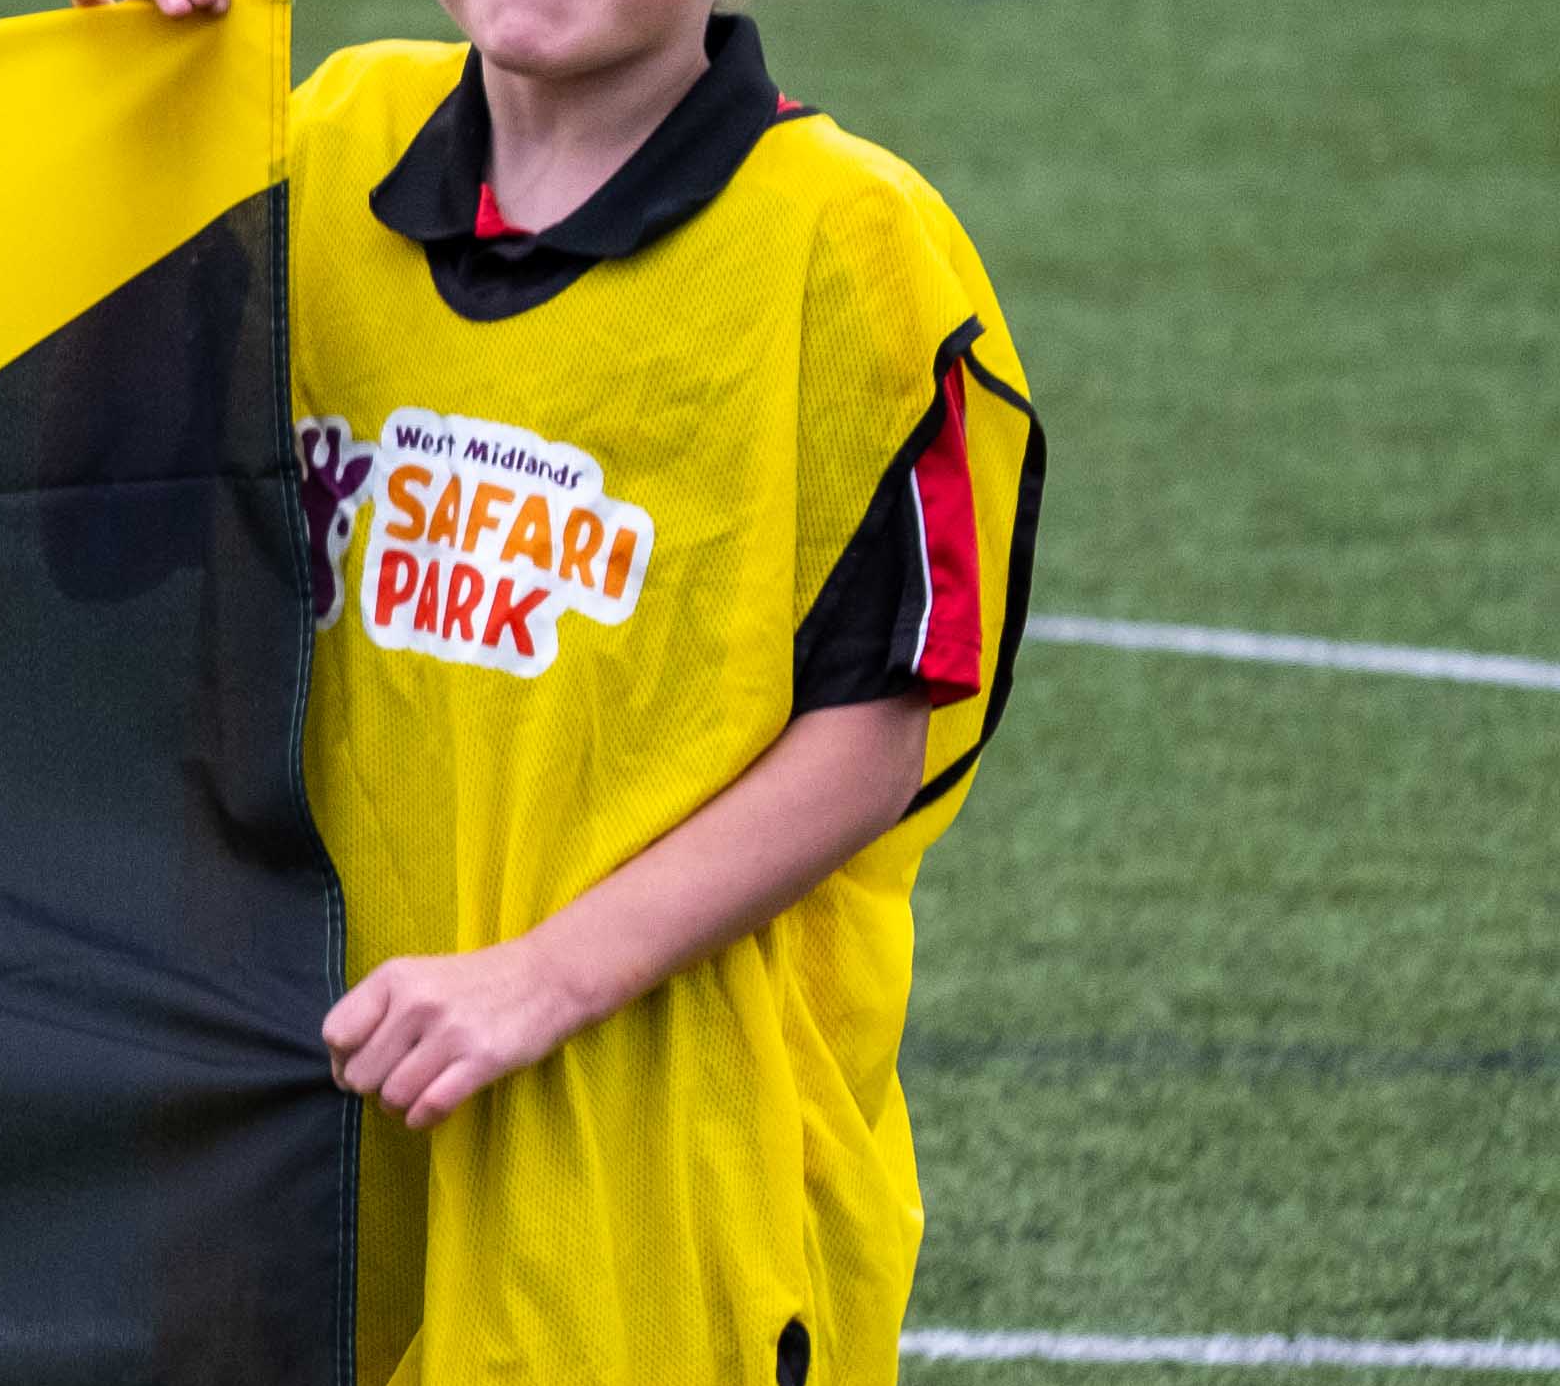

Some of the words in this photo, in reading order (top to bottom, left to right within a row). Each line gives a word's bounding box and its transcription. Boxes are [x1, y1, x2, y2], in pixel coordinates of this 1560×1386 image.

[395, 424, 457, 459] West
[463, 437, 584, 491] Midlands
[384, 463, 639, 600] SAFARI
[374, 549, 552, 658] PARK
